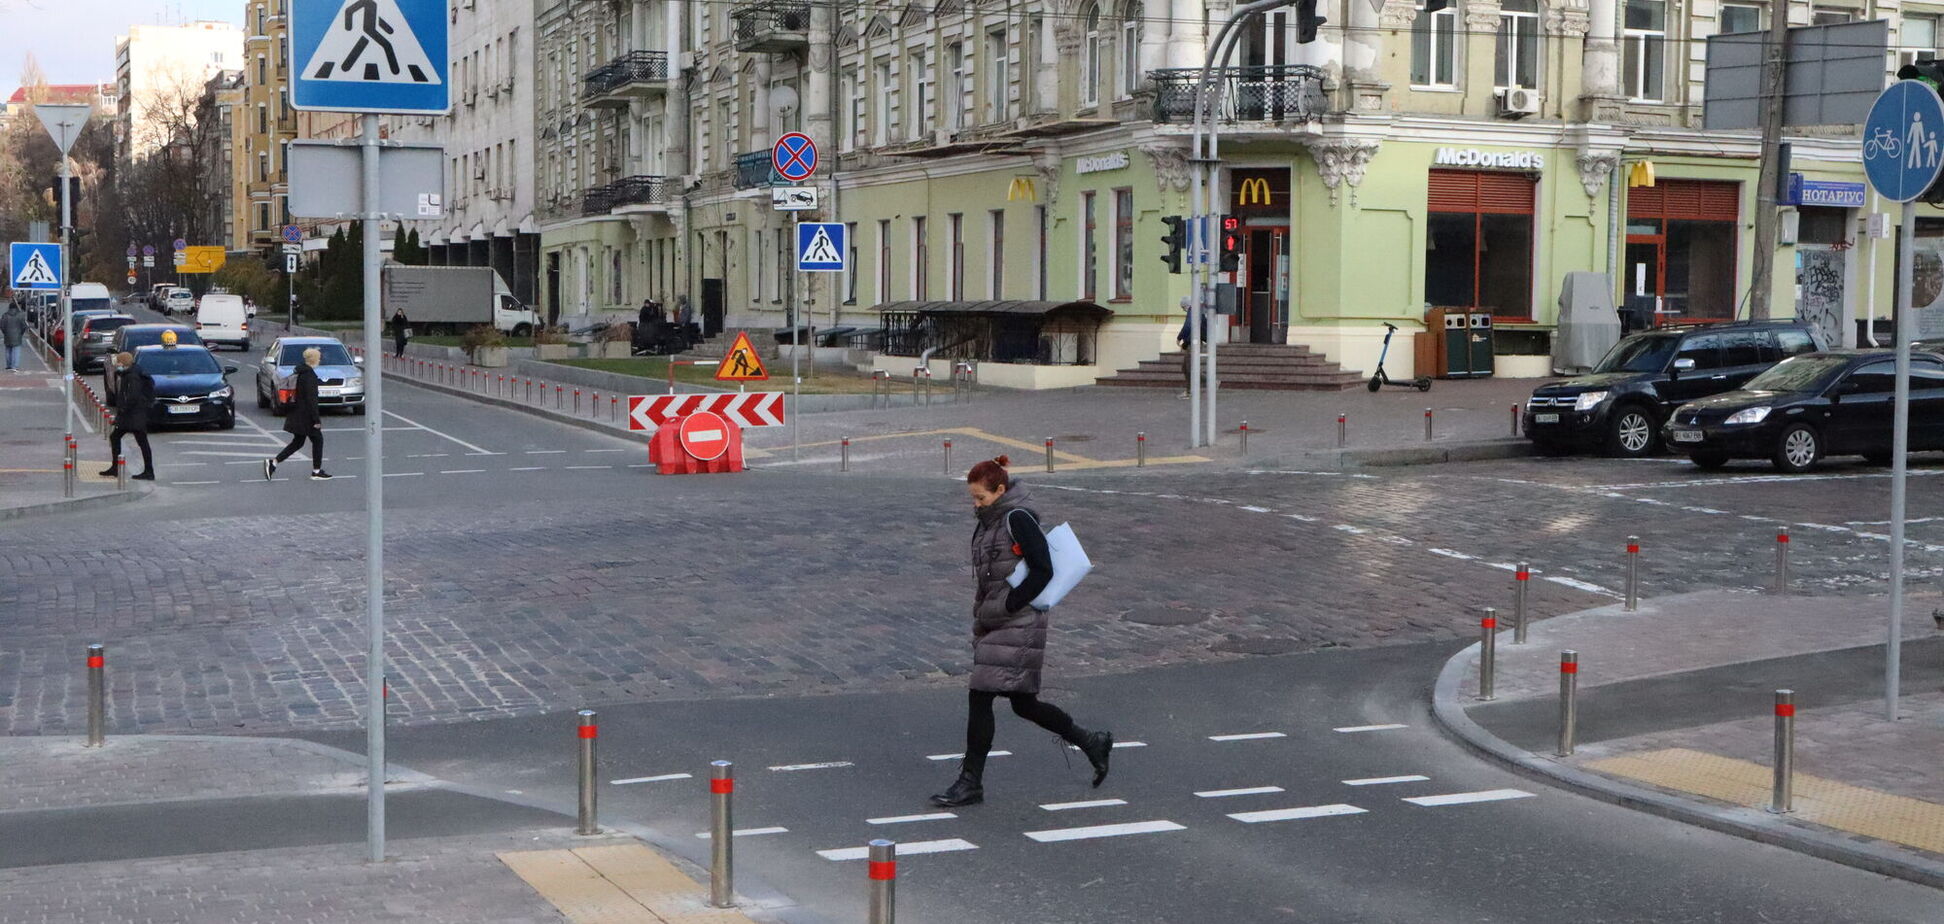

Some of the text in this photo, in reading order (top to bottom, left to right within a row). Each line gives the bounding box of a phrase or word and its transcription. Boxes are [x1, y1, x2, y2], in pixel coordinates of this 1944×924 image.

[1435, 147, 1545, 168] McDonald's
[1802, 189, 1864, 203] НОТАРІУС
[1224, 218, 1238, 230] 57
